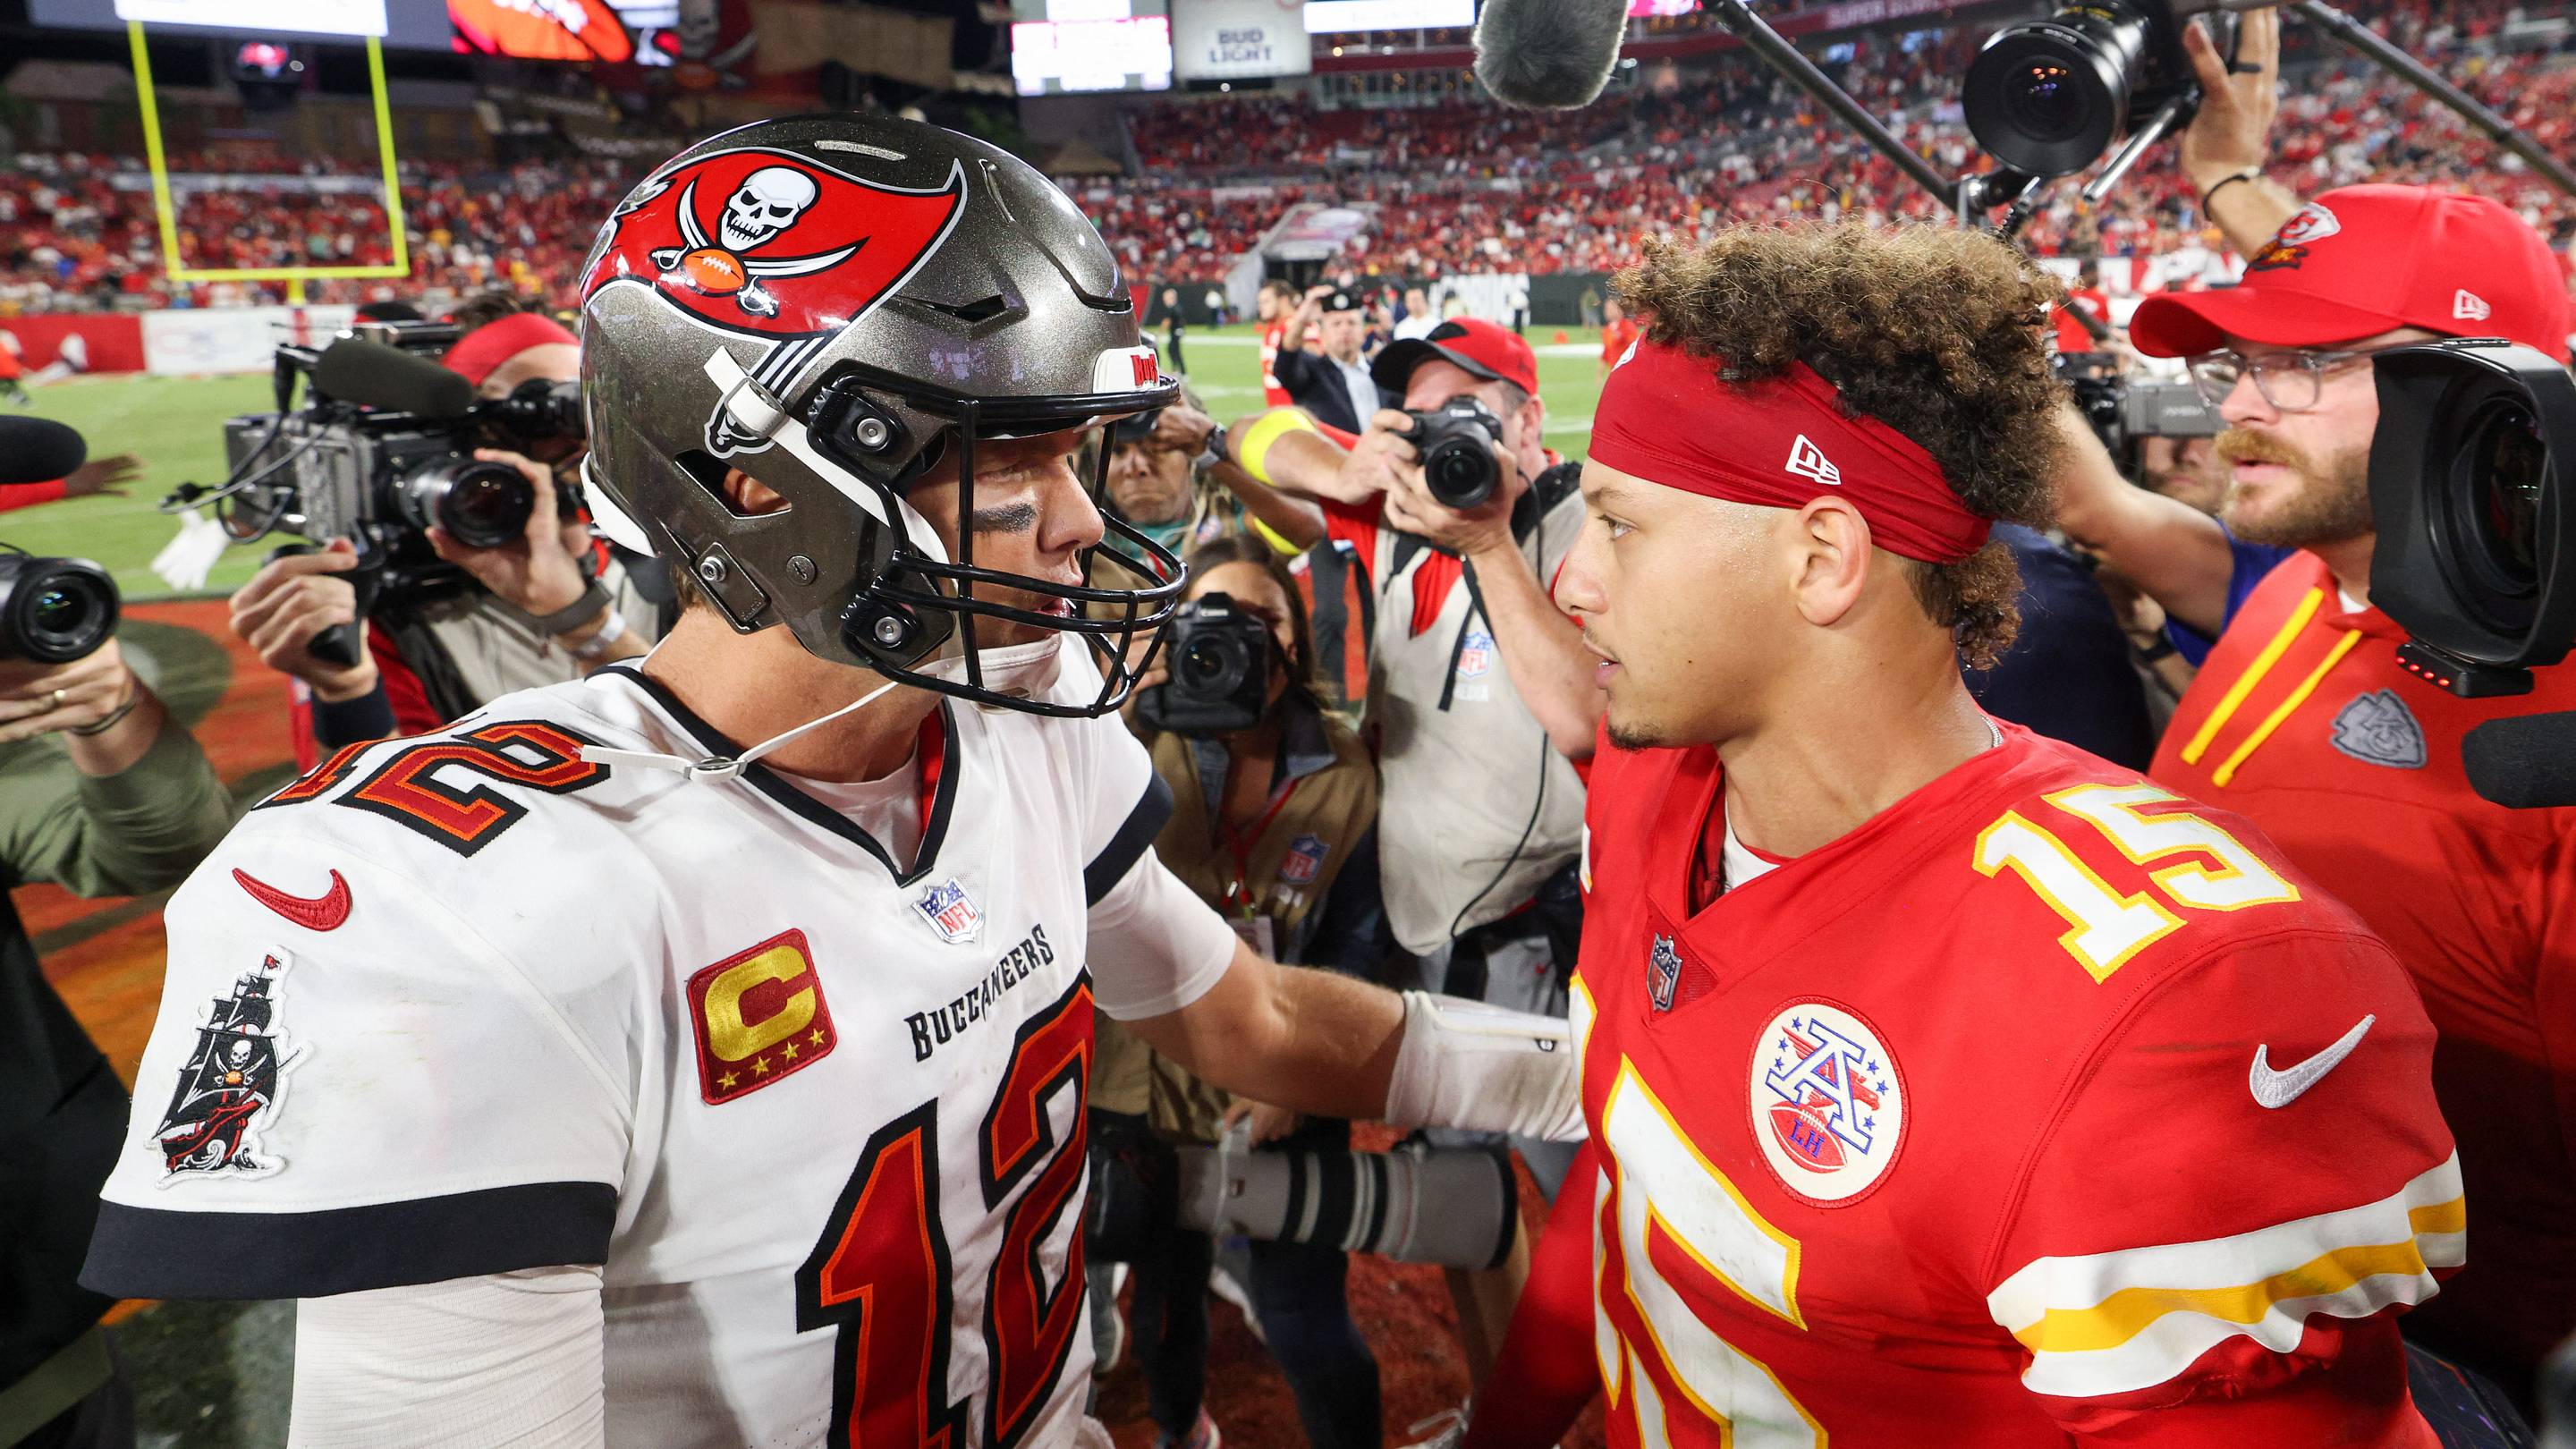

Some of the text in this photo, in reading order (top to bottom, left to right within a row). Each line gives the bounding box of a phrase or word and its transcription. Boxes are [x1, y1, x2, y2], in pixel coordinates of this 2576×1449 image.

[1208, 45, 1273, 63] LIGHT
[1217, 29, 1264, 44] BUD
[1460, 650, 1487, 673] NFL
[250, 712, 611, 859] 12
[1282, 852, 1319, 878] NFL
[1971, 779, 2302, 985] 15
[938, 902, 977, 934] NFL
[704, 945, 817, 1062] C
[903, 923, 1055, 1063] BUCCANEERS
[1788, 1119, 1826, 1158] LH
[793, 964, 1096, 1449] 12
